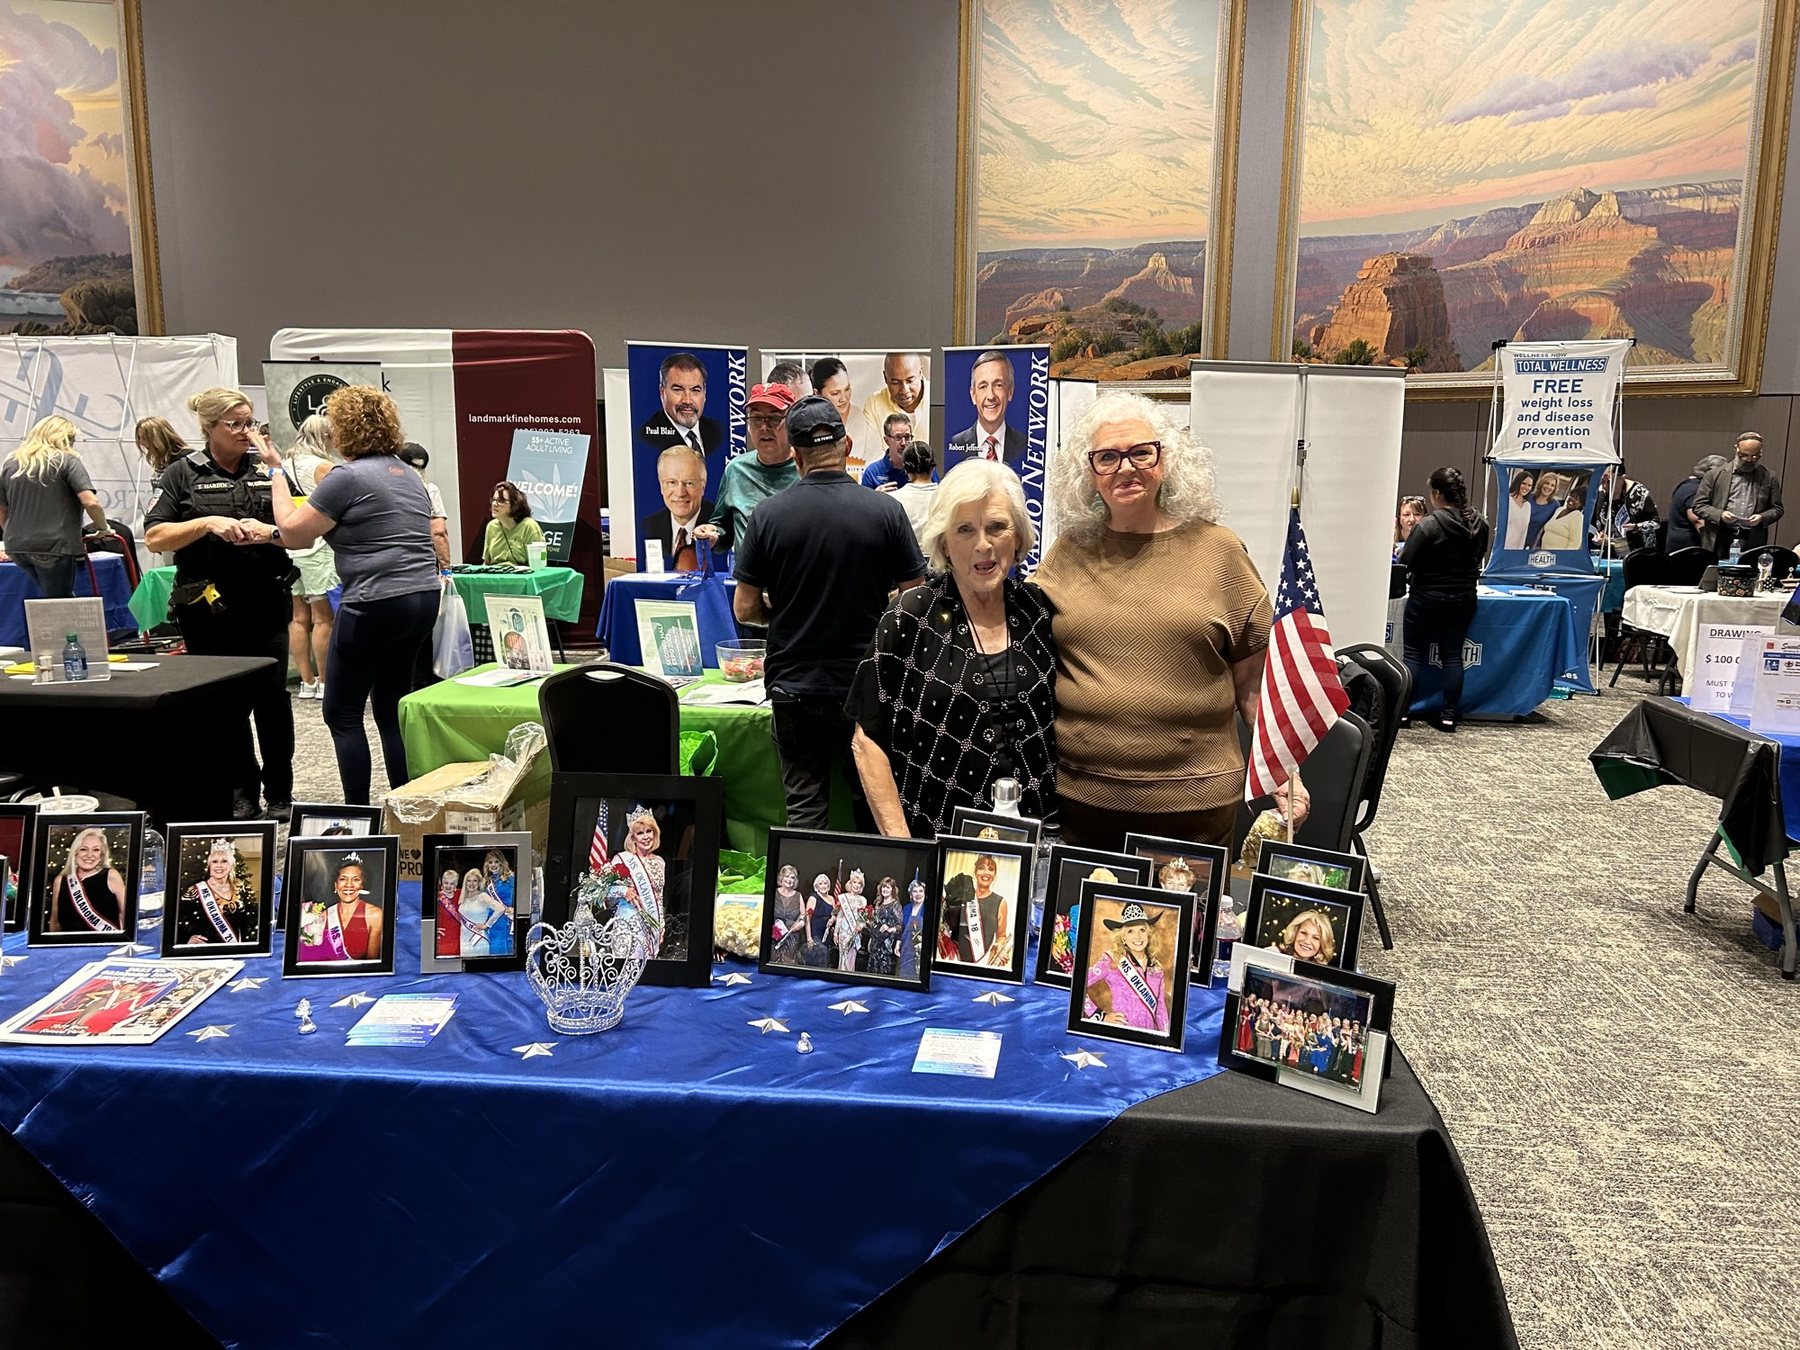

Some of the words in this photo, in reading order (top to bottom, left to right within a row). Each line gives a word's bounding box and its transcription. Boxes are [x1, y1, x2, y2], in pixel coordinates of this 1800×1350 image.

[1517, 360, 1547, 372] TOTAL
[1549, 358, 1605, 372] WELLNESS
[1533, 378, 1584, 394] FREE
[1521, 398, 1563, 411] weight
[1567, 397, 1593, 408] loss
[468, 413, 582, 424] landmarkfinehomes.com
[1021, 352, 1049, 491] NETWORK
[1517, 411, 1540, 422] and
[1545, 411, 1594, 422] disease
[645, 426, 659, 435] Paul
[660, 427, 676, 435] Blair
[1517, 426, 1590, 438] prevention
[544, 437, 570, 447] ACTIVE
[948, 443, 965, 451] Robert
[1521, 440, 1583, 451] program
[525, 444, 549, 453] ADULT
[549, 445, 573, 455] LIVING
[1530, 555, 1554, 564] HEALTH
[1705, 654, 1711, 664] $
[1714, 655, 1732, 664] 100
[72, 889, 101, 927] OKLAHOMA
[206, 900, 229, 935] OKLAHOMA
[970, 923, 979, 932] 18
[330, 925, 341, 943] MS.
[1130, 975, 1157, 1010] OKLAHOMA
